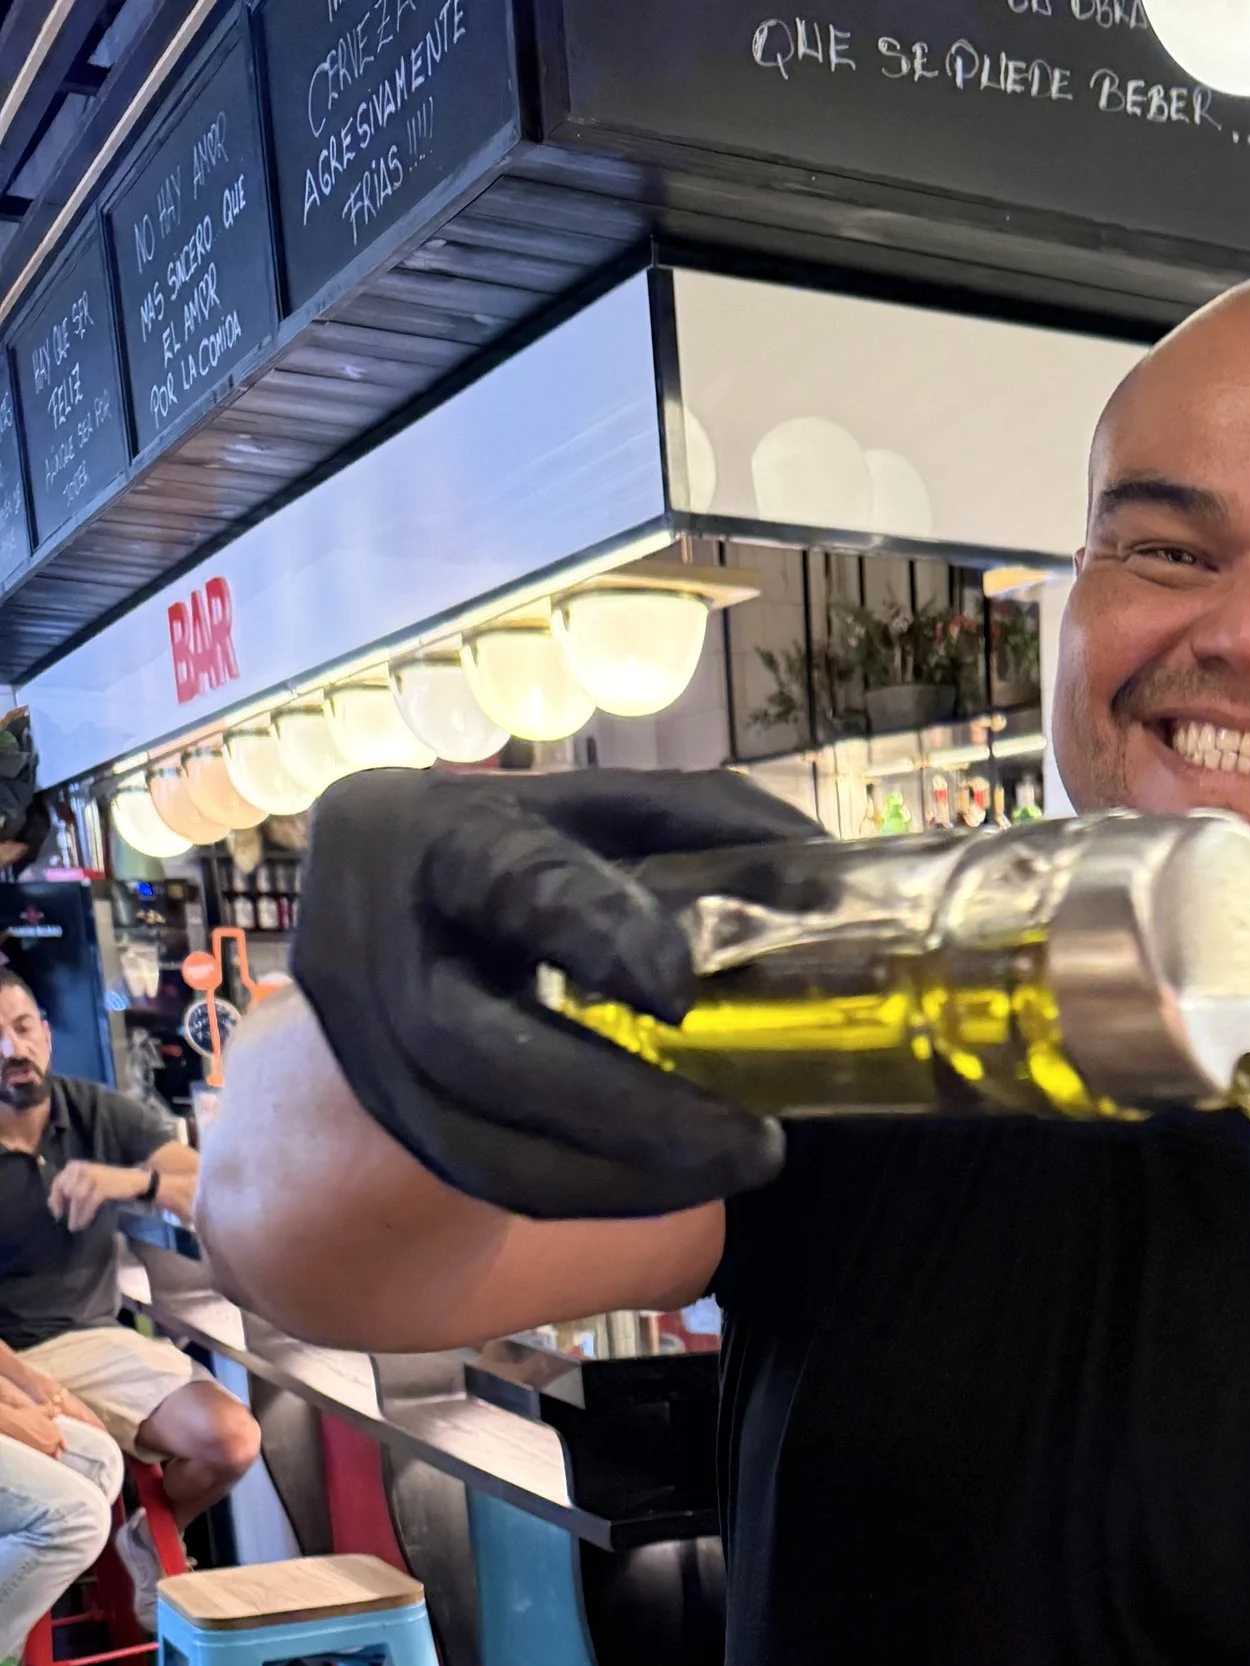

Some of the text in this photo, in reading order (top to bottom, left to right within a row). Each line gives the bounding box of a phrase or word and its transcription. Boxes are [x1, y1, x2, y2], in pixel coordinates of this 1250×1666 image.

[304, 0, 465, 226] AGRESIVAMENTE
[752, 17, 856, 80] QUE
[878, 36, 939, 82] SE
[946, 38, 1073, 100] PUEDE
[134, 111, 230, 274] NO HAY AMOR
[167, 213, 213, 301] SINCERO
[222, 173, 247, 230] QUE
[151, 308, 242, 429] POR LA COMIDA
[162, 262, 222, 369] EL AMOR
[48, 361, 84, 430] FELIZ
[168, 576, 240, 705] BAR
